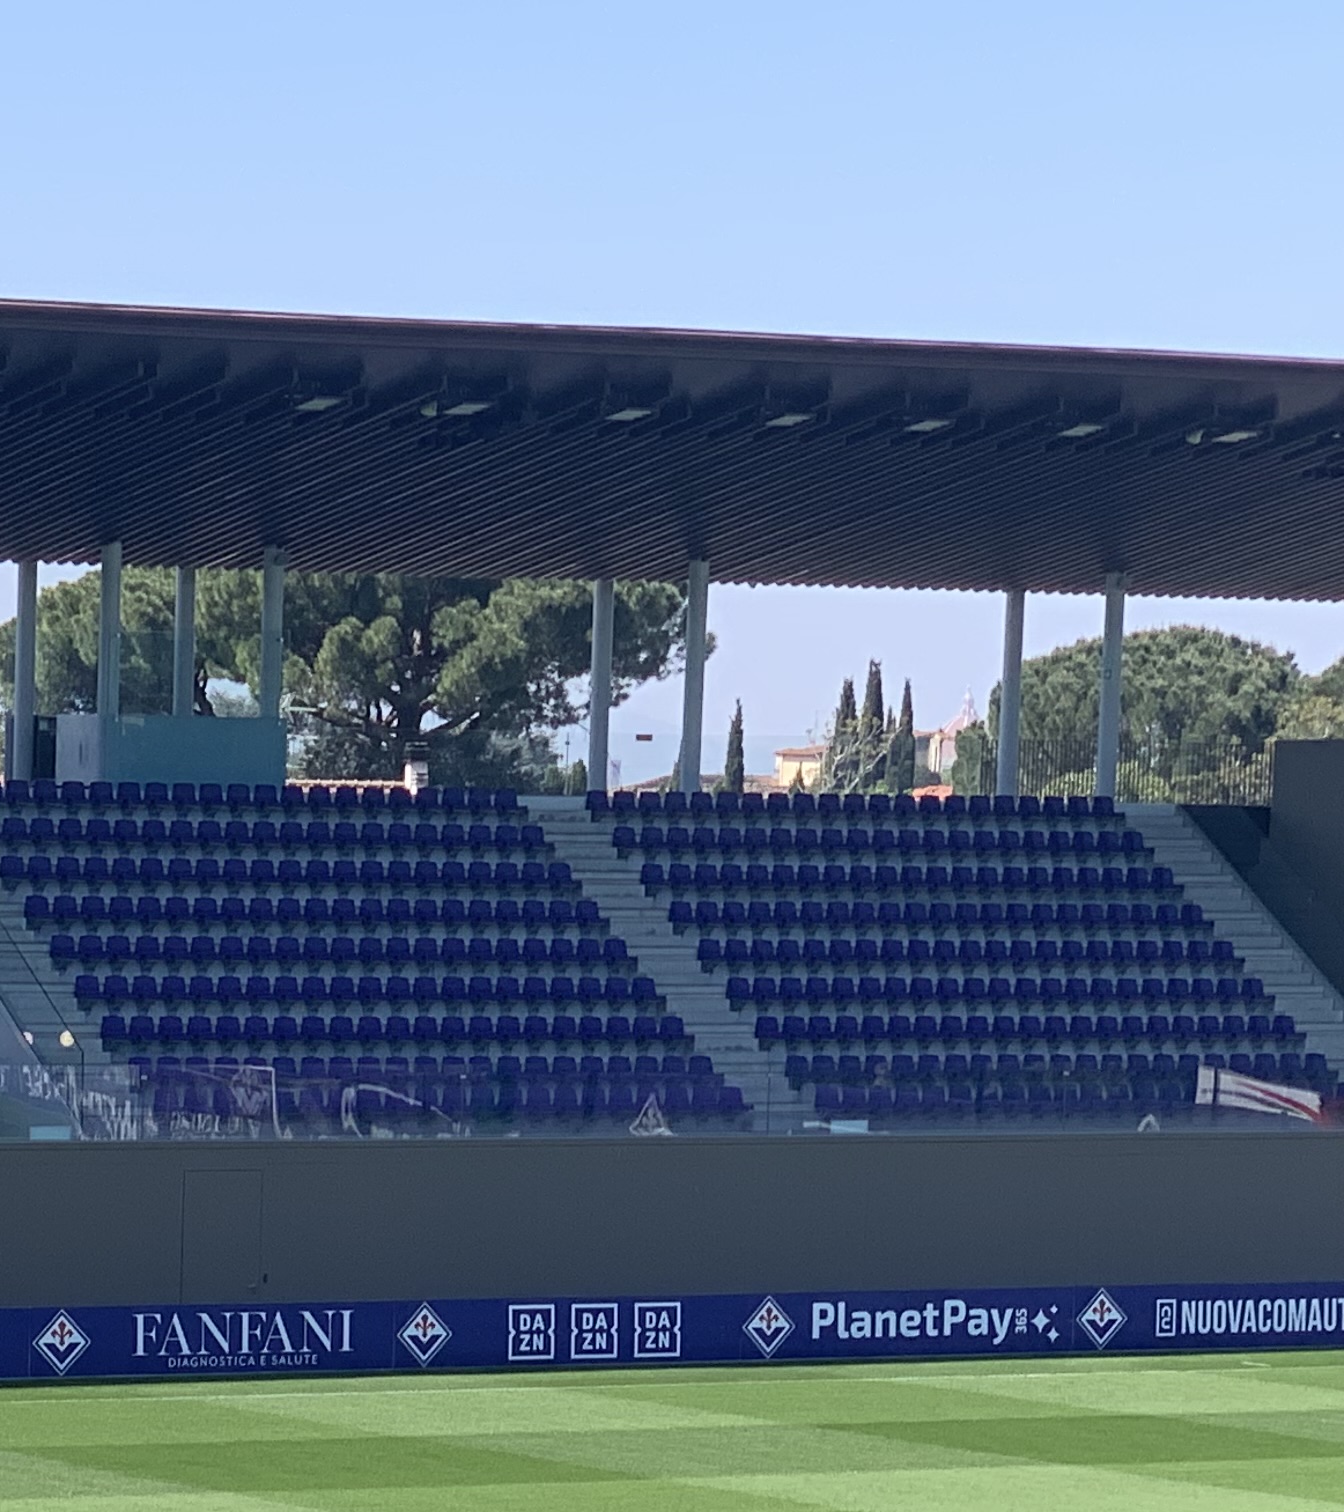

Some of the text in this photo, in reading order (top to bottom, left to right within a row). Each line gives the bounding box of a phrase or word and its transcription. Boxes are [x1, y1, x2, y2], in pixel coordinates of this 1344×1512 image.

[132, 1309, 355, 1357] FANFANI
[812, 1299, 1014, 1346] PlanetPay
[168, 1354, 319, 1369] DIAGNOSTICA E SALUTE
